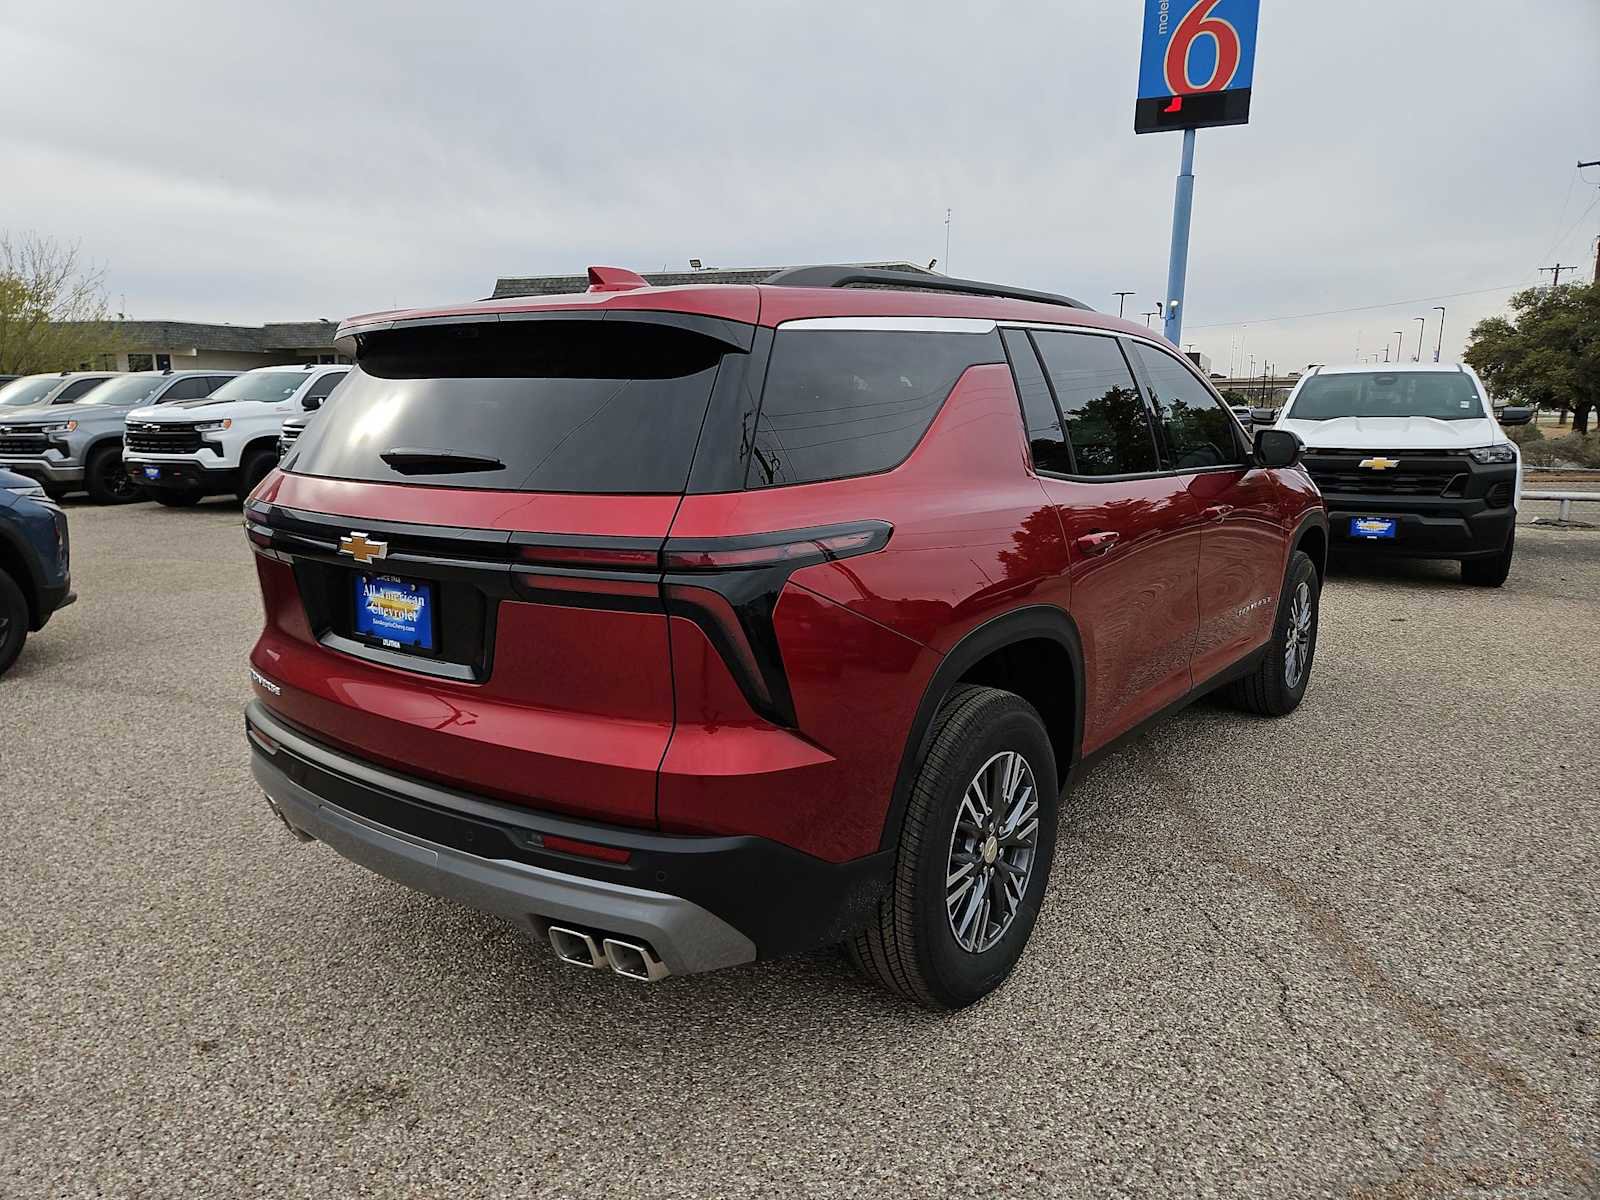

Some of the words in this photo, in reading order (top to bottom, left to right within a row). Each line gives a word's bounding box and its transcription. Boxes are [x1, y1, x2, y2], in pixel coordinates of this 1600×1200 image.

[1164, 0, 1241, 96] 6
[363, 583, 376, 598] All
[376, 587, 425, 607] American
[371, 600, 418, 622] Chevrolet
